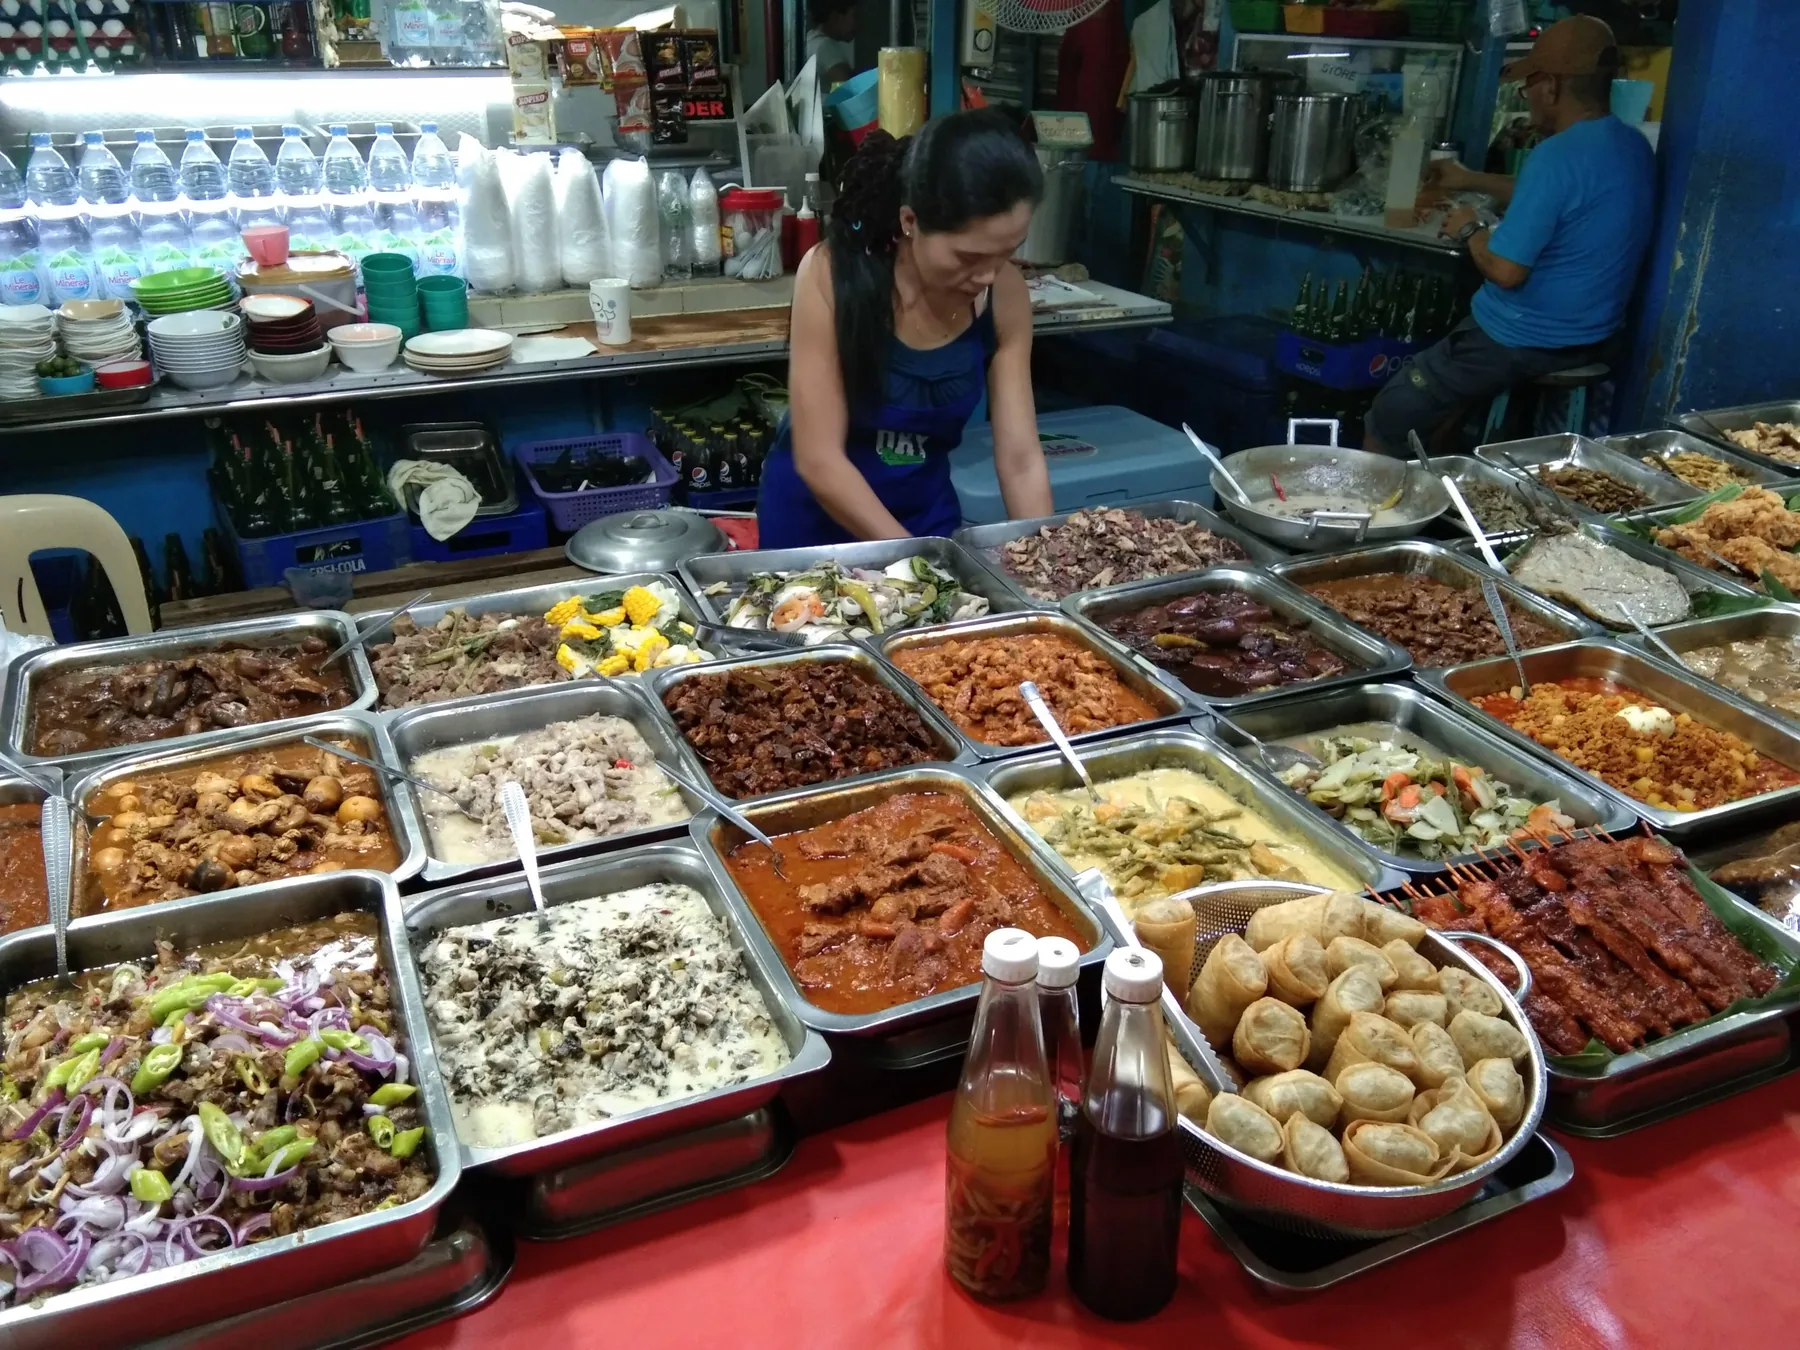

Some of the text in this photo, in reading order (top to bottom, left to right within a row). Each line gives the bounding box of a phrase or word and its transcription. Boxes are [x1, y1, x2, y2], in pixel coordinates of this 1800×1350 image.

[1321, 63, 1357, 81] STORE
[518, 94, 545, 104] KOPIKO
[14, 276, 25, 284] Le
[64, 272, 75, 281] Le
